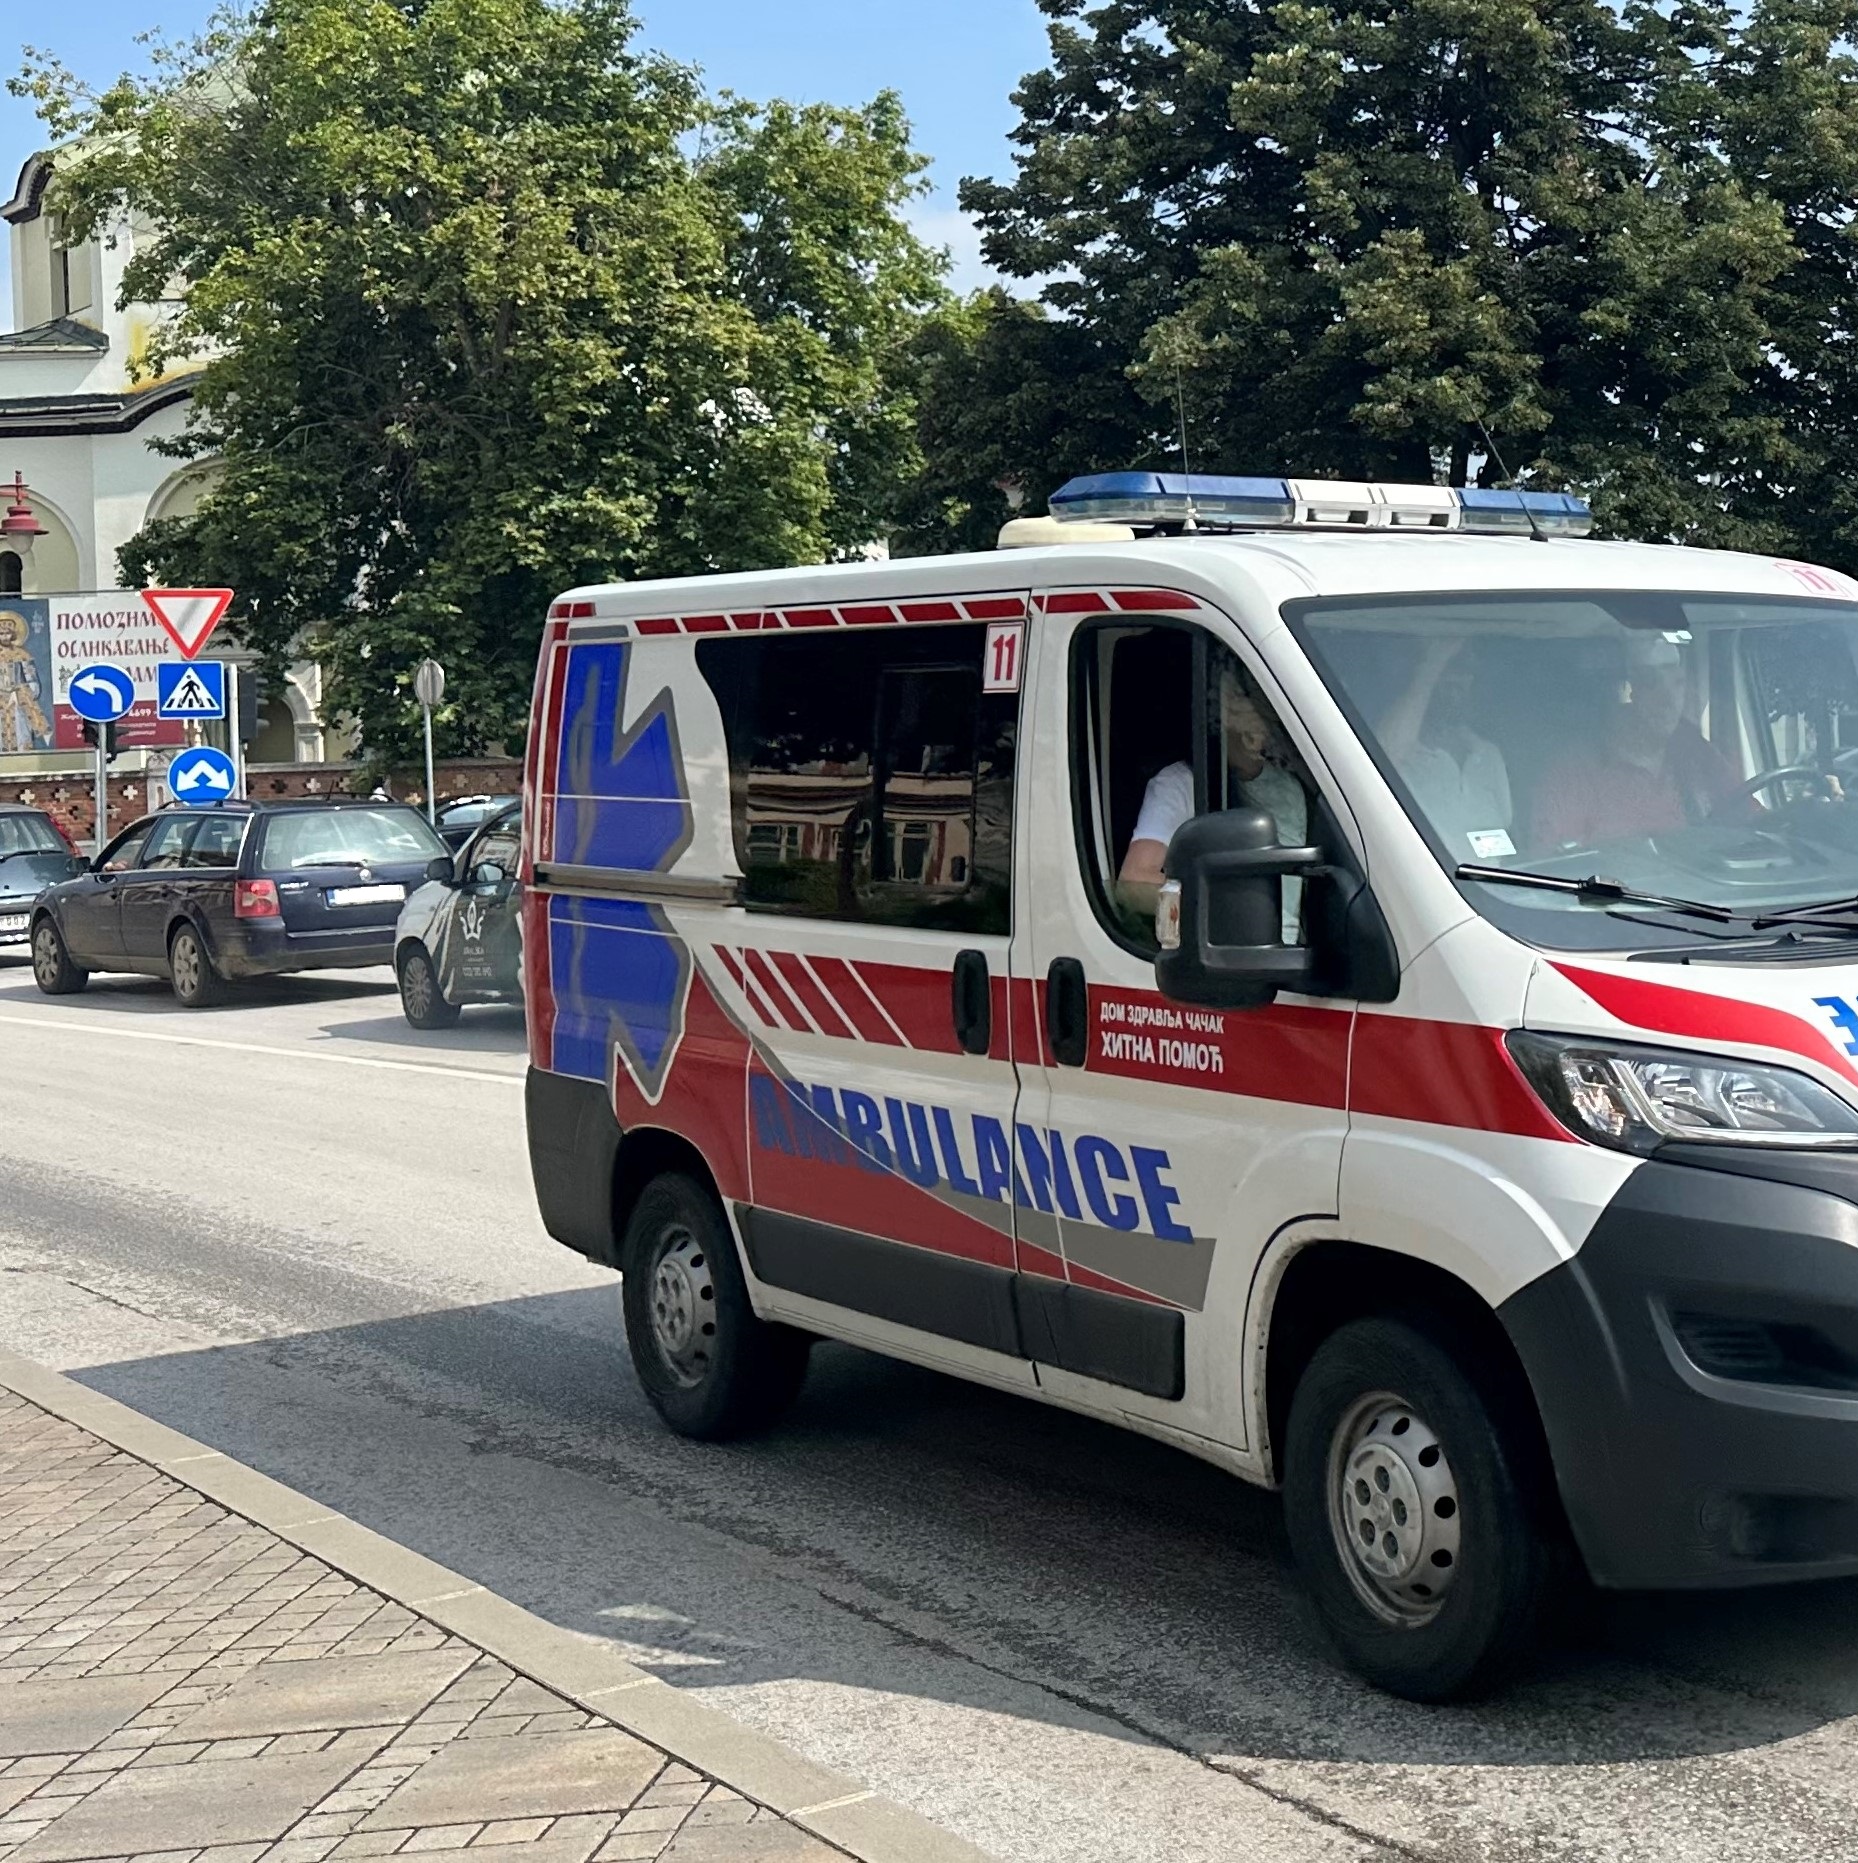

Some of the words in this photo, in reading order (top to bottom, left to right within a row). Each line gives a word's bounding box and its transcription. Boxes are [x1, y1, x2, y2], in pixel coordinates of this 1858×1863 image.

[57, 611, 160, 637] ПОМОЗИМ
[992, 633, 1016, 681] 11
[1100, 1002, 1125, 1023] ДОМ
[1127, 1004, 1184, 1029] ЗДРАВЉА
[1185, 1011, 1224, 1034] ЧАЧАК
[1101, 1031, 1156, 1064] ХИТНА
[1158, 1038, 1224, 1074] ПОМОЋ
[749, 1072, 1195, 1244] AMBULANCE
